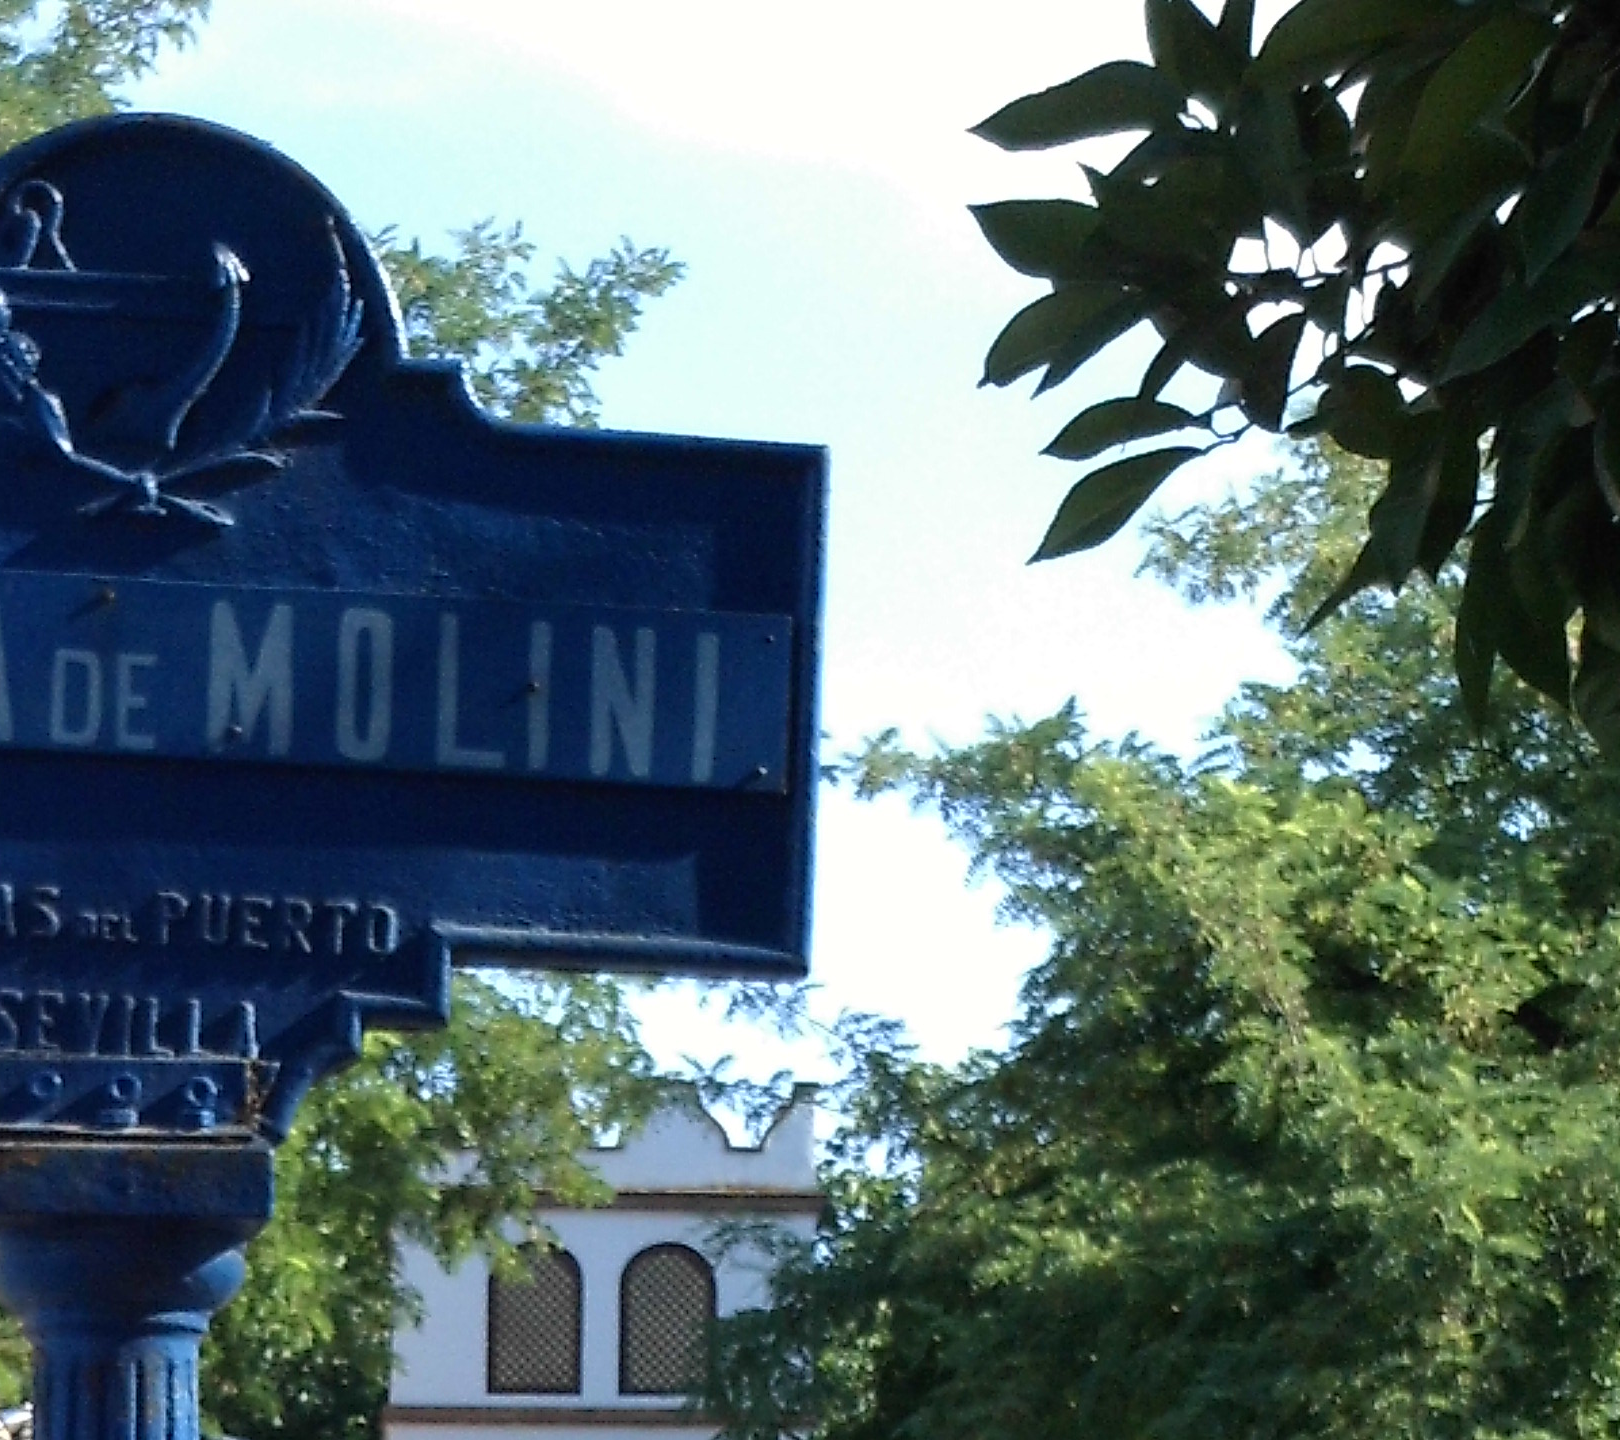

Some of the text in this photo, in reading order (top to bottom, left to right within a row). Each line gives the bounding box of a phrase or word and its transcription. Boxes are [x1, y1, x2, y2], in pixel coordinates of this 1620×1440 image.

[49, 647, 160, 751] DE
[205, 600, 722, 784] MOLINI
[79, 910, 140, 943] DEL
[157, 890, 401, 955] PUERTO
